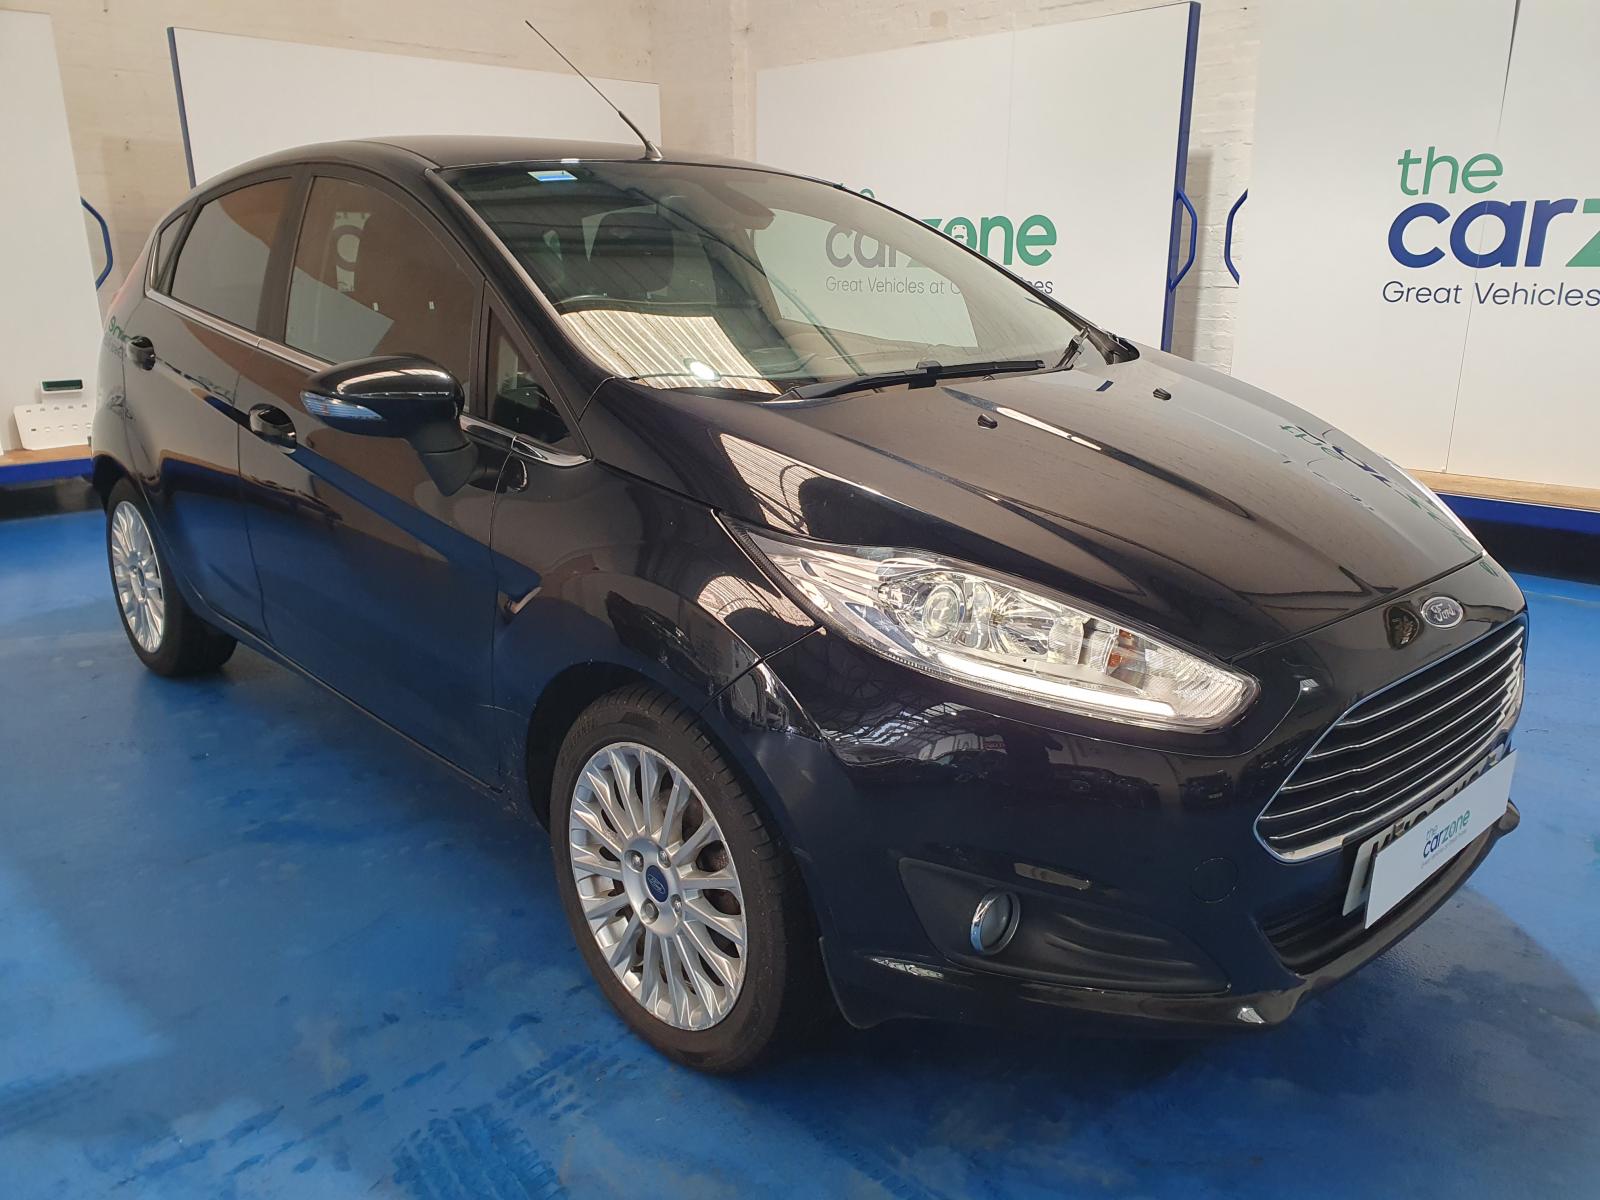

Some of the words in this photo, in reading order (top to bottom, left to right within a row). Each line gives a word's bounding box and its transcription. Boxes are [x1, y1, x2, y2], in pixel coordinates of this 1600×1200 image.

[1398, 146, 1503, 196] the
[825, 276, 862, 293] Great
[868, 277, 924, 294] Vehicles
[929, 279, 945, 294] at
[1382, 280, 1462, 304] Great
[1475, 281, 1600, 306] Vehicles
[1423, 810, 1470, 858] carzone
